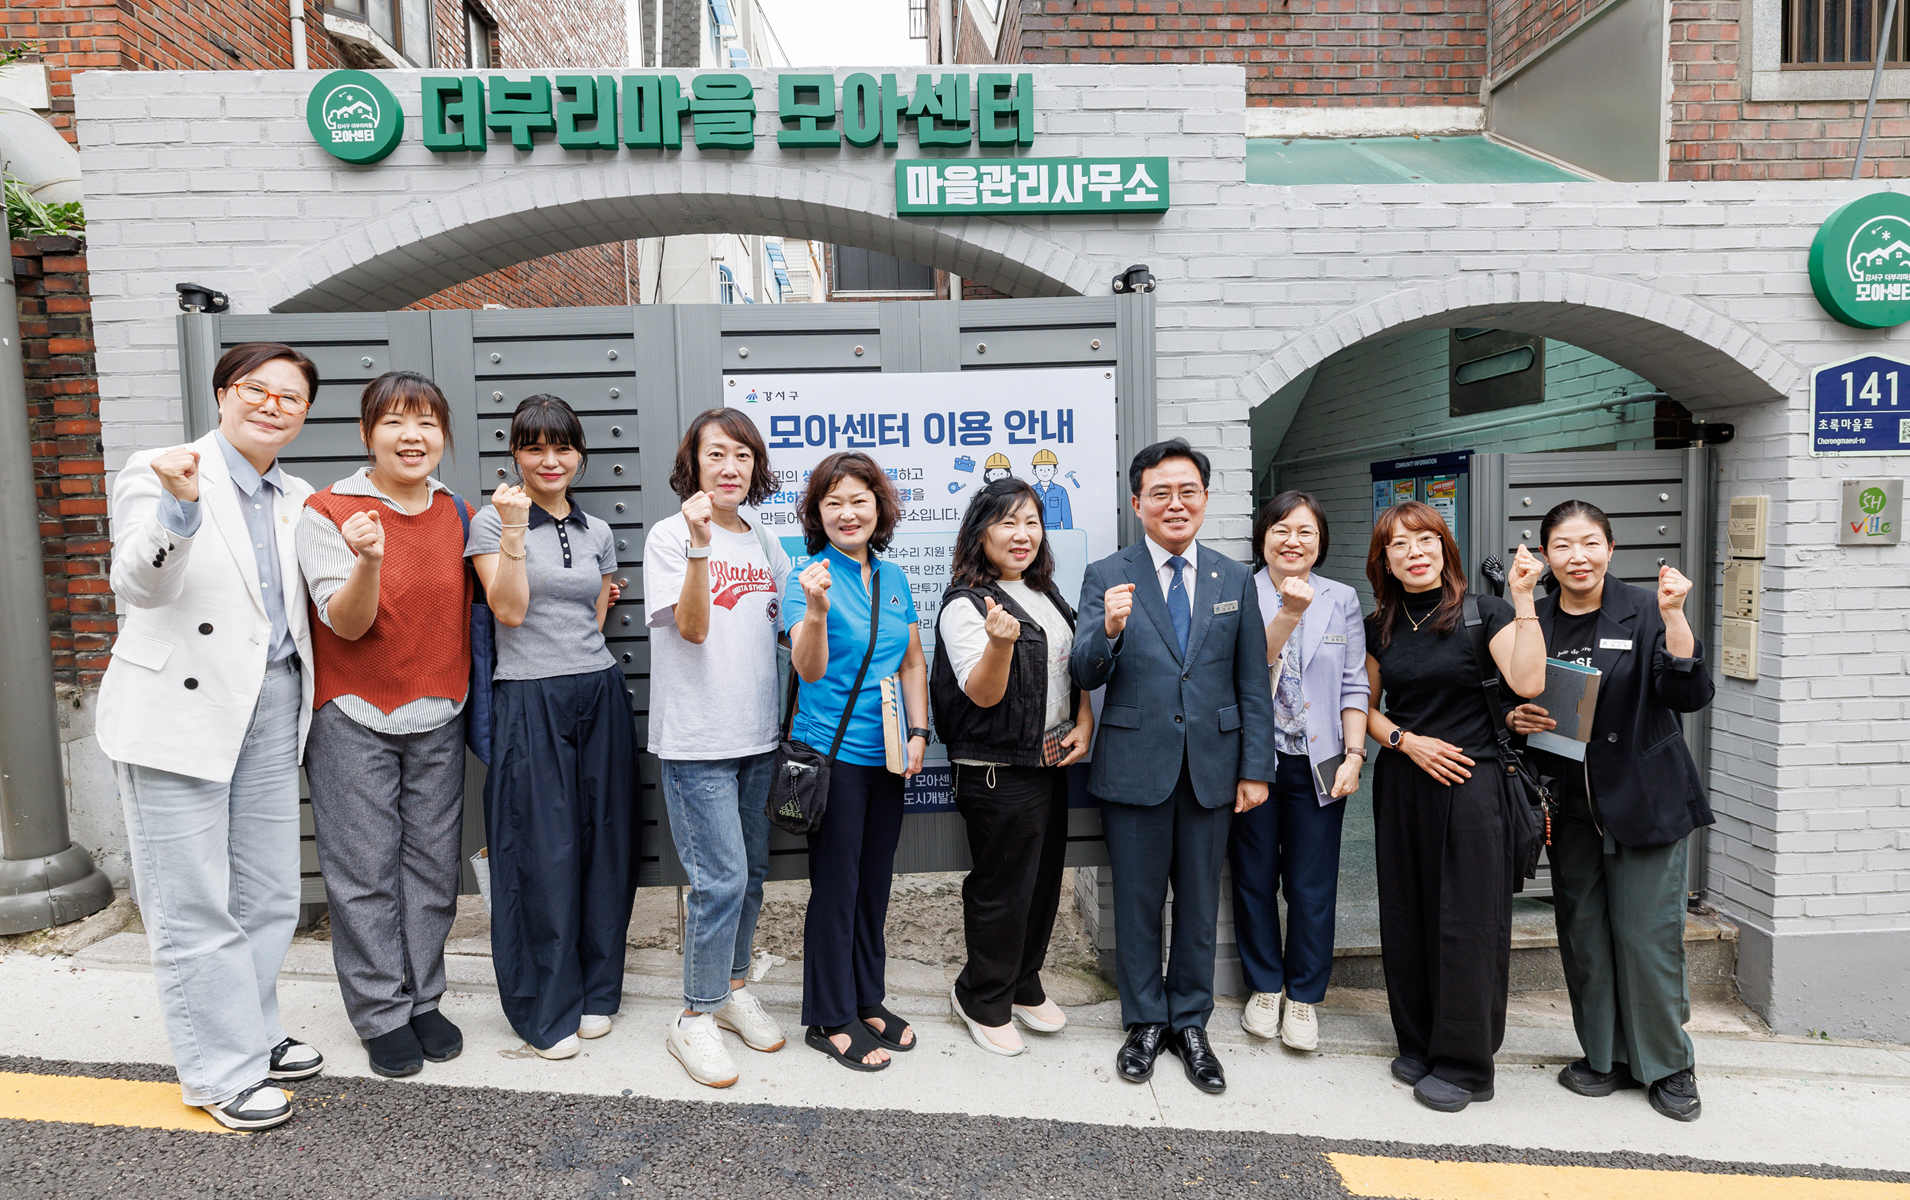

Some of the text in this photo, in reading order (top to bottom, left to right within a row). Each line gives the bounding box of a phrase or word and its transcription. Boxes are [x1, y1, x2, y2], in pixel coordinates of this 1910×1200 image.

[421, 72, 1034, 152] 더부리마을 모아센터
[332, 129, 375, 142] 모아센터
[906, 163, 1159, 205] 마을관리사무소
[1865, 273, 1910, 282] 강서구 더부리마
[1841, 371, 1898, 406] 141
[762, 391, 799, 401] 강서구
[769, 408, 1074, 449] 모아센터 이용 안내
[1818, 418, 1874, 432] 초록마을로
[1817, 437, 1866, 446] Chorongmaeul-ro
[1414, 458, 1437, 466] INFORMATION
[888, 547, 920, 558] 집수리
[924, 546, 945, 558] 지원
[923, 564, 945, 576] 안전
[925, 601, 935, 612] 내
[915, 773, 953, 788] 모아센
